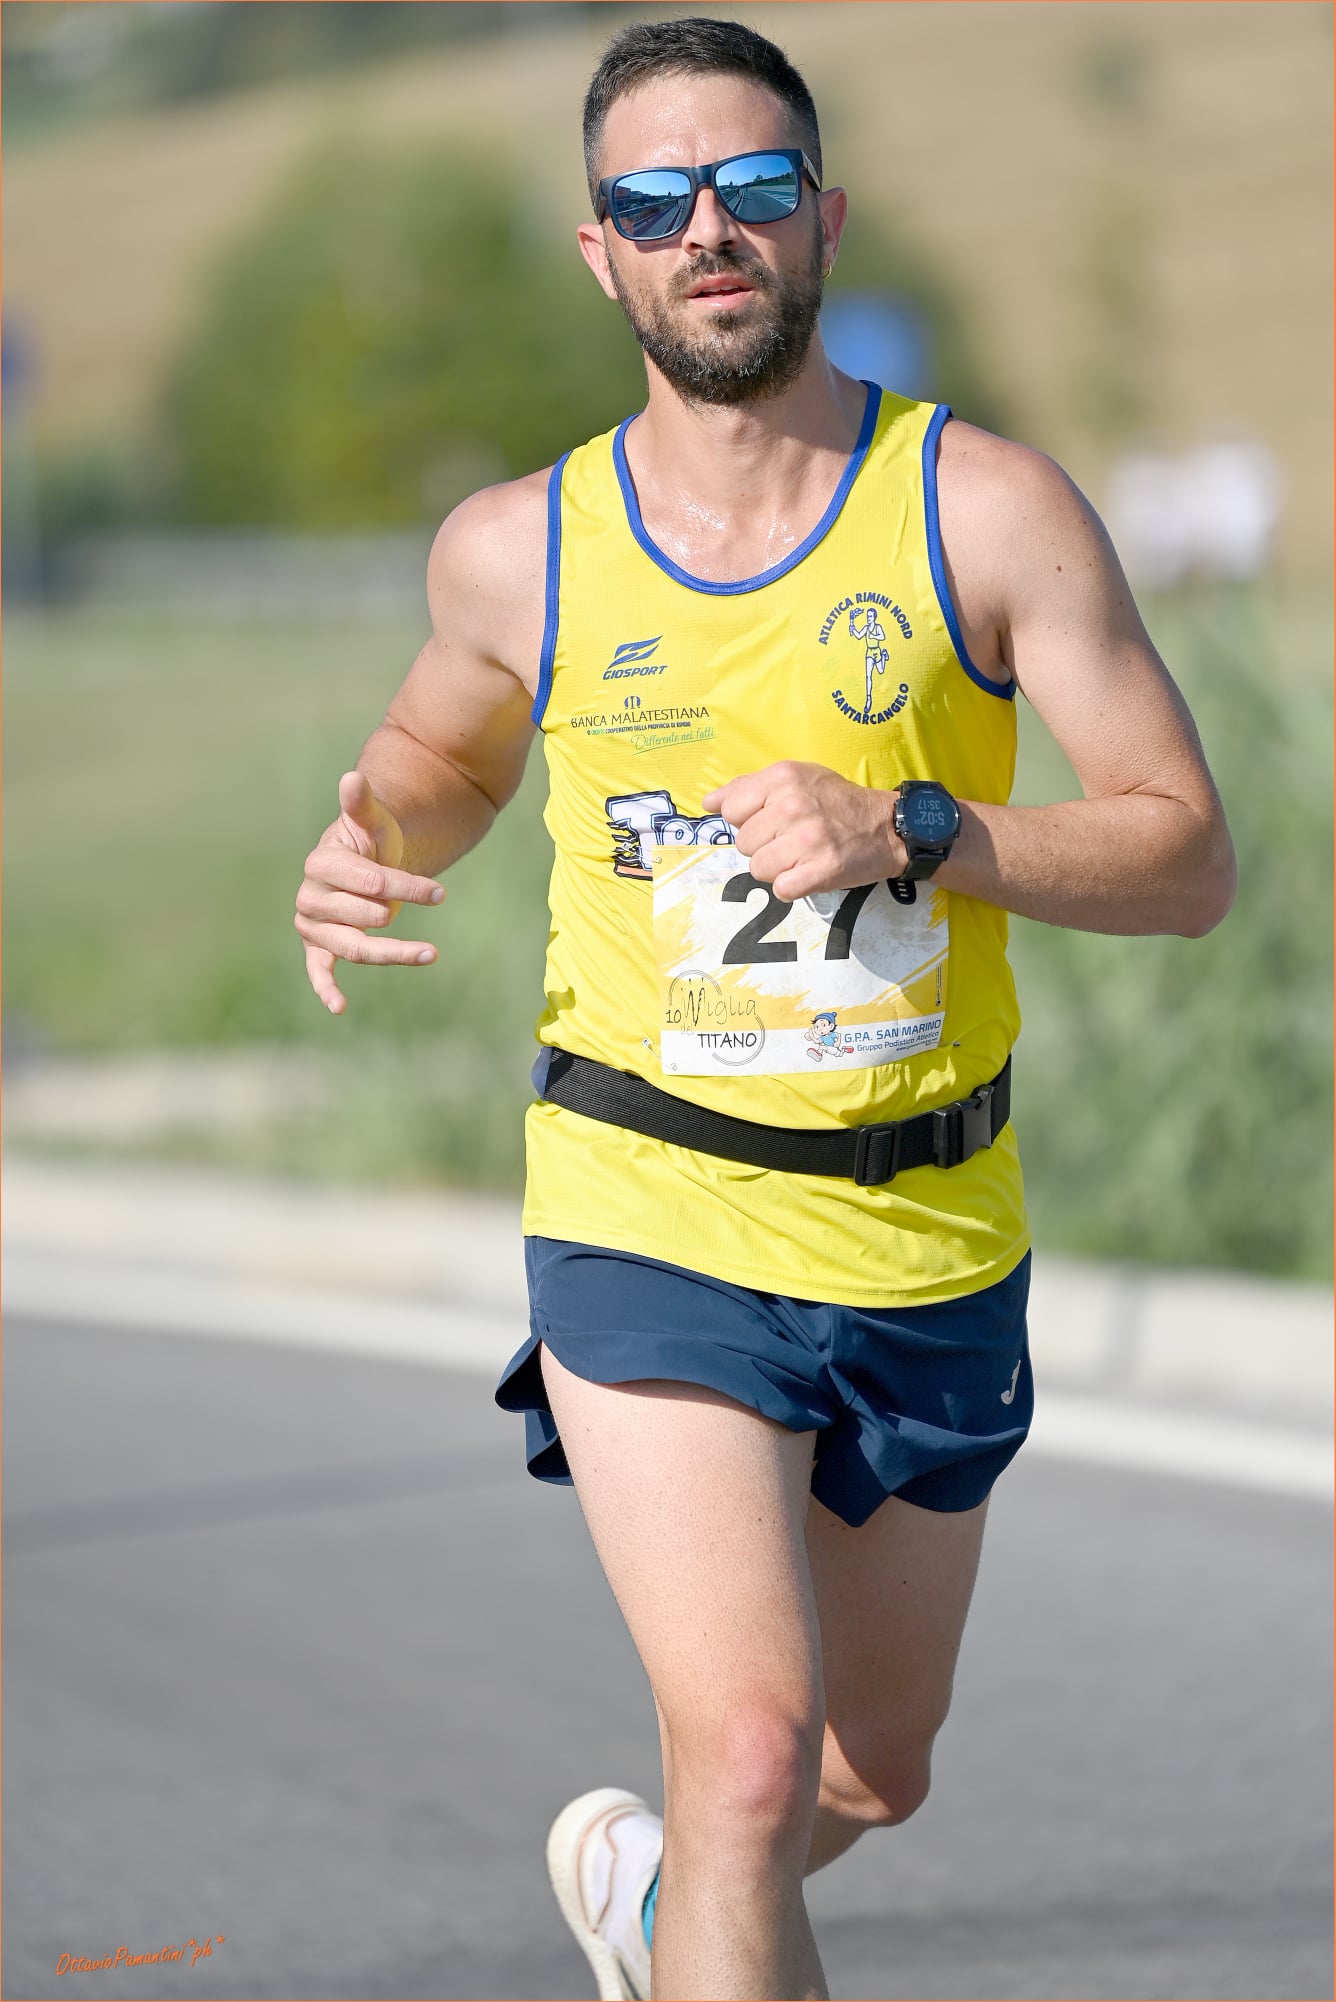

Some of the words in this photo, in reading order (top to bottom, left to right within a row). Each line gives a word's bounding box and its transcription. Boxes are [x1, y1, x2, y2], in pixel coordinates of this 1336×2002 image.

[818, 597, 854, 645] ATLETICA
[855, 592, 893, 609] RIMINI
[890, 604, 913, 640] NORD
[602, 664, 668, 681] GIOSPORT
[831, 682, 909, 725] SANTARCANGELO
[570, 715, 608, 729] BANCA
[611, 706, 710, 725] MALATESTIANA
[630, 731, 680, 751] Differente
[695, 727, 716, 741] fatti
[665, 1009, 682, 1024] 10
[697, 1031, 758, 1049] TITANO
[844, 1031, 873, 1044] G.P.A.
[876, 1027, 899, 1040] SAN
[901, 1019, 942, 1036] MARINO
[857, 1041, 883, 1052] Gruppo
[884, 1036, 915, 1048] Podistico
[915, 1030, 940, 1042] Atletico
